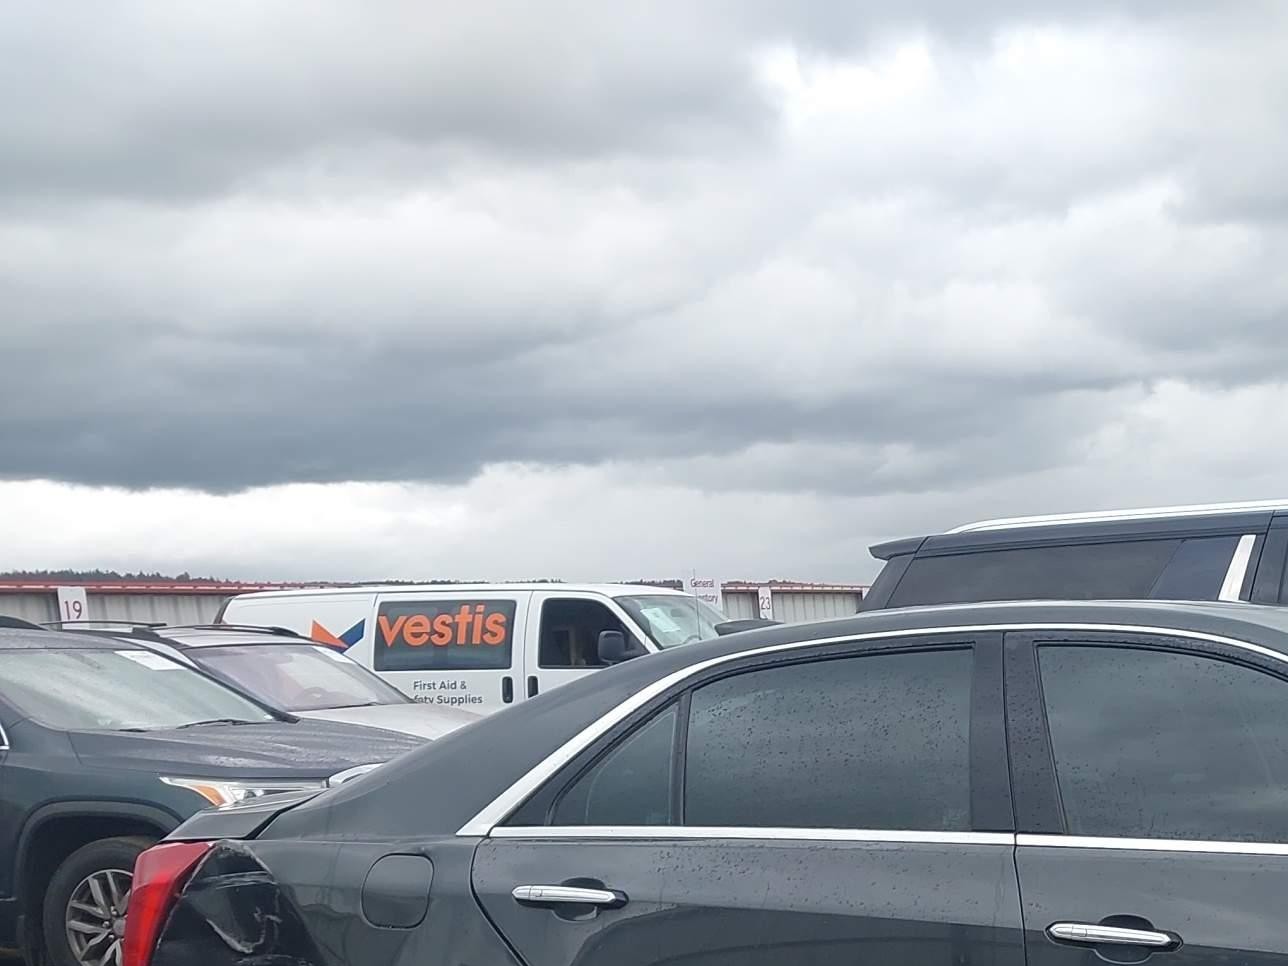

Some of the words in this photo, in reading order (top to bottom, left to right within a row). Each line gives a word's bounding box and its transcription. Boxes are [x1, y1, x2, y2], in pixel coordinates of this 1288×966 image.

[690, 578, 715, 588] General
[760, 596, 771, 610] 23
[64, 600, 82, 620] 19
[378, 604, 507, 647] vestis
[413, 680, 436, 691] First
[439, 680, 457, 690] Aid
[460, 681, 467, 690] &
[436, 693, 483, 706] Supplies
